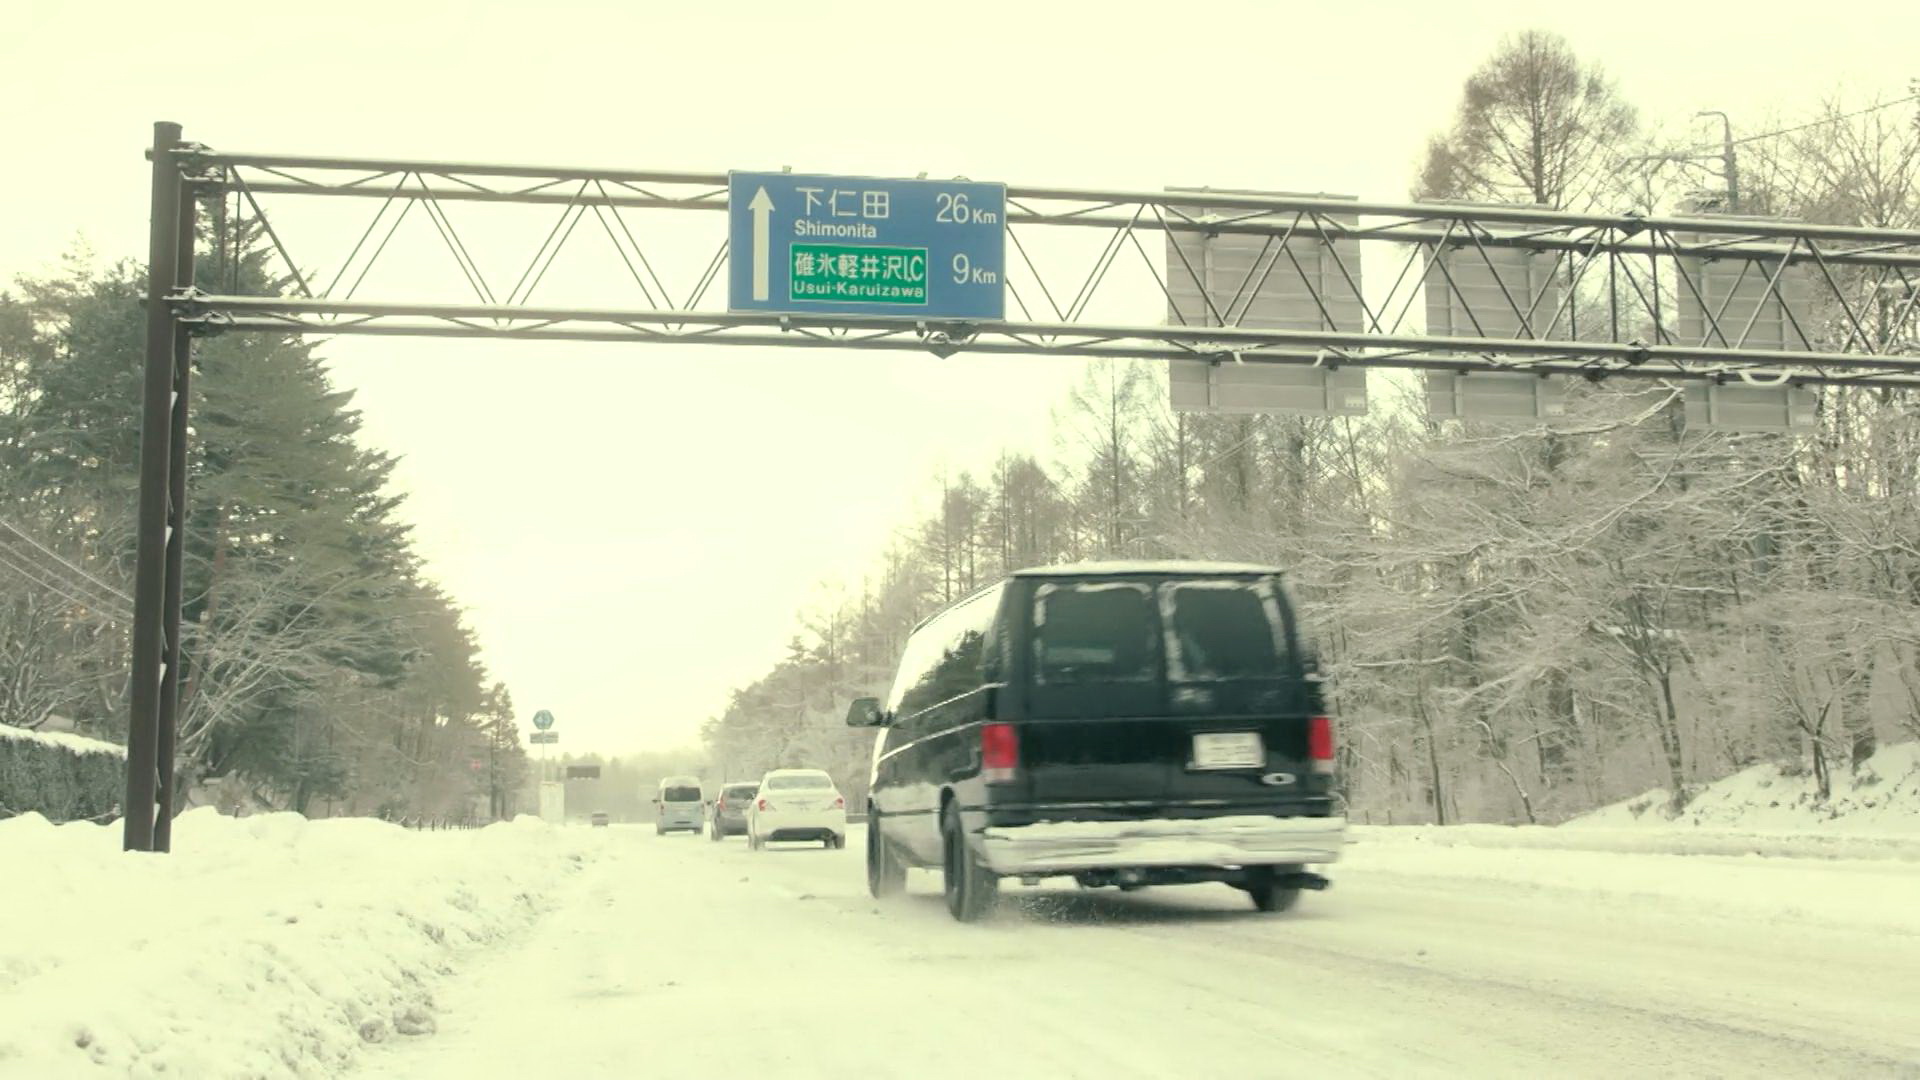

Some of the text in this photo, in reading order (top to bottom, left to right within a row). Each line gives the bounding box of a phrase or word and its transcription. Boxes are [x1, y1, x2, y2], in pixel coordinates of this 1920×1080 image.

[796, 187, 889, 218] 下仁田
[936, 193, 969, 223] 26
[795, 220, 877, 238] Shimonita
[953, 254, 969, 284] 9
[794, 280, 924, 297] Usui-Karuizawa
